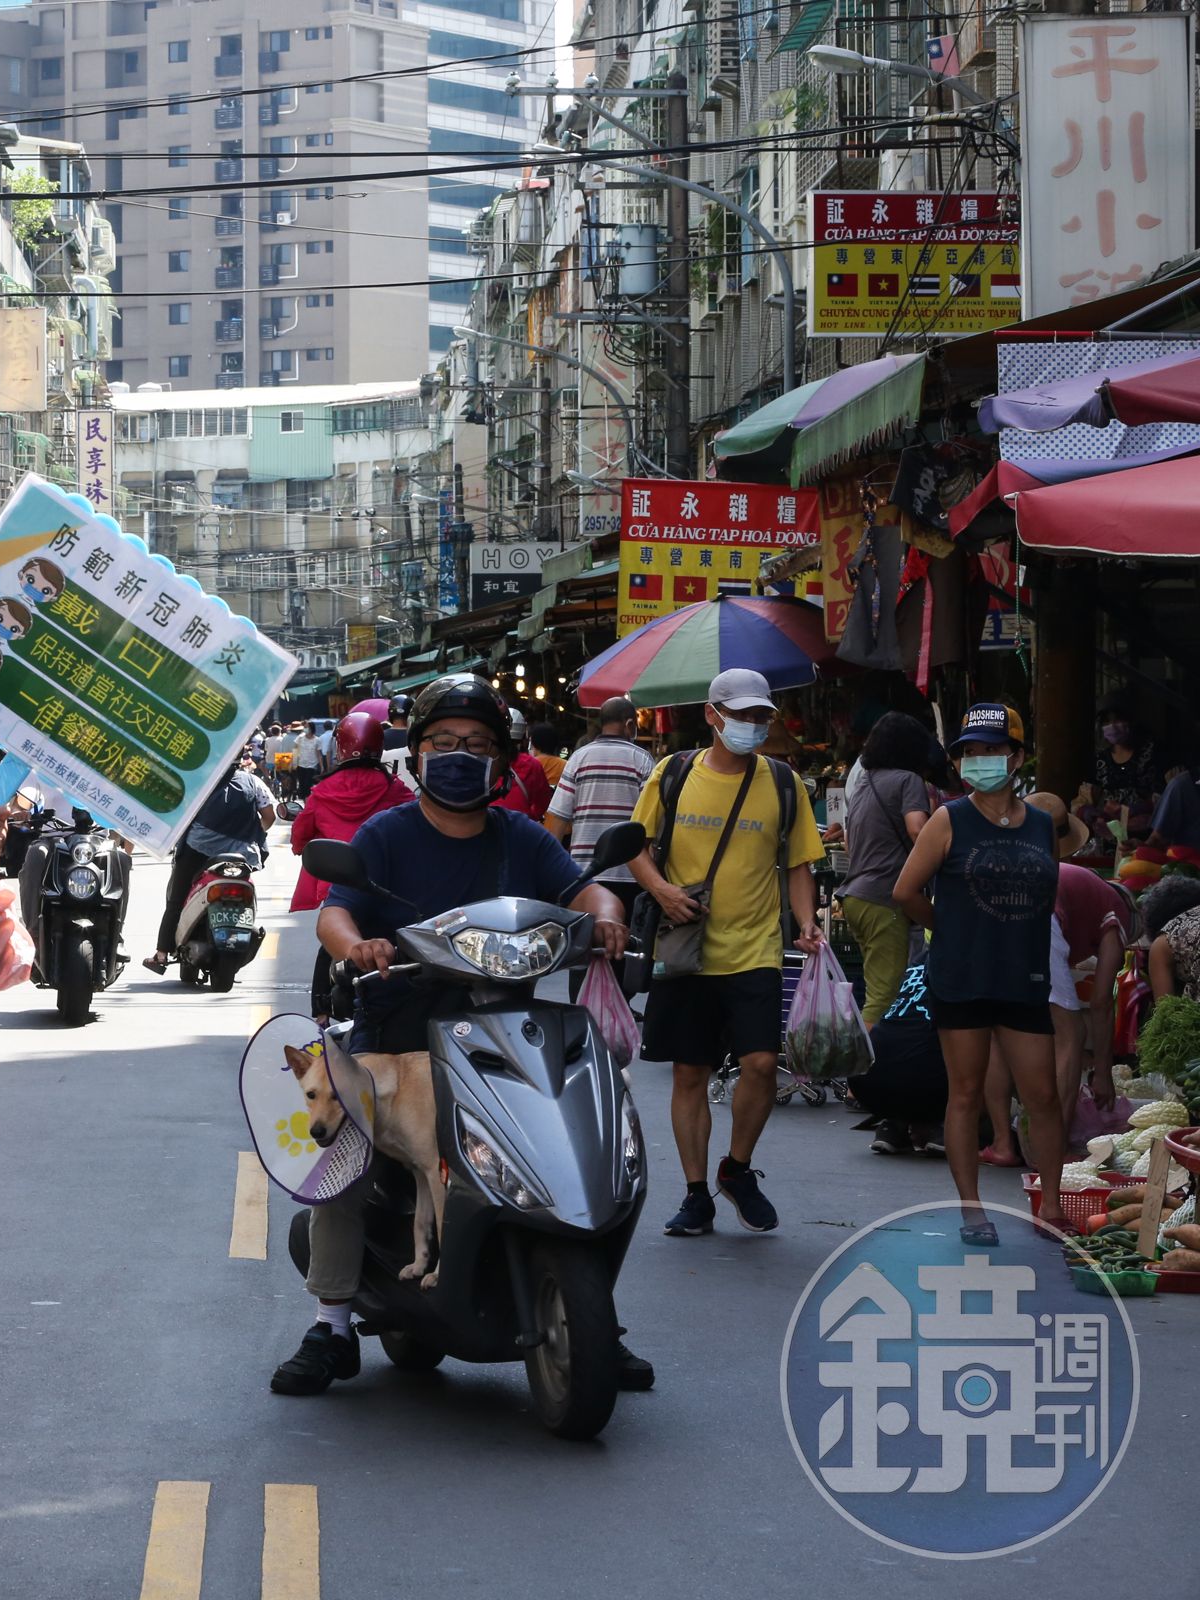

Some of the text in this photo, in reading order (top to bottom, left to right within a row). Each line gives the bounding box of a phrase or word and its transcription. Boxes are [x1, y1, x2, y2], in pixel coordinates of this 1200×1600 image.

[820, 321, 839, 329] HOT
[662, 523, 706, 540] HÀNG
[48, 523, 246, 675] 防範新冠肺炎
[30, 632, 195, 761] 保持適當社交距離
[50, 590, 228, 722] 戴口罩
[19, 690, 150, 787] 一律餐點外帶
[20, 738, 153, 837] 新北市板橋區公所 關心您
[675, 813, 724, 828] HANG
[736, 818, 764, 832] EN
